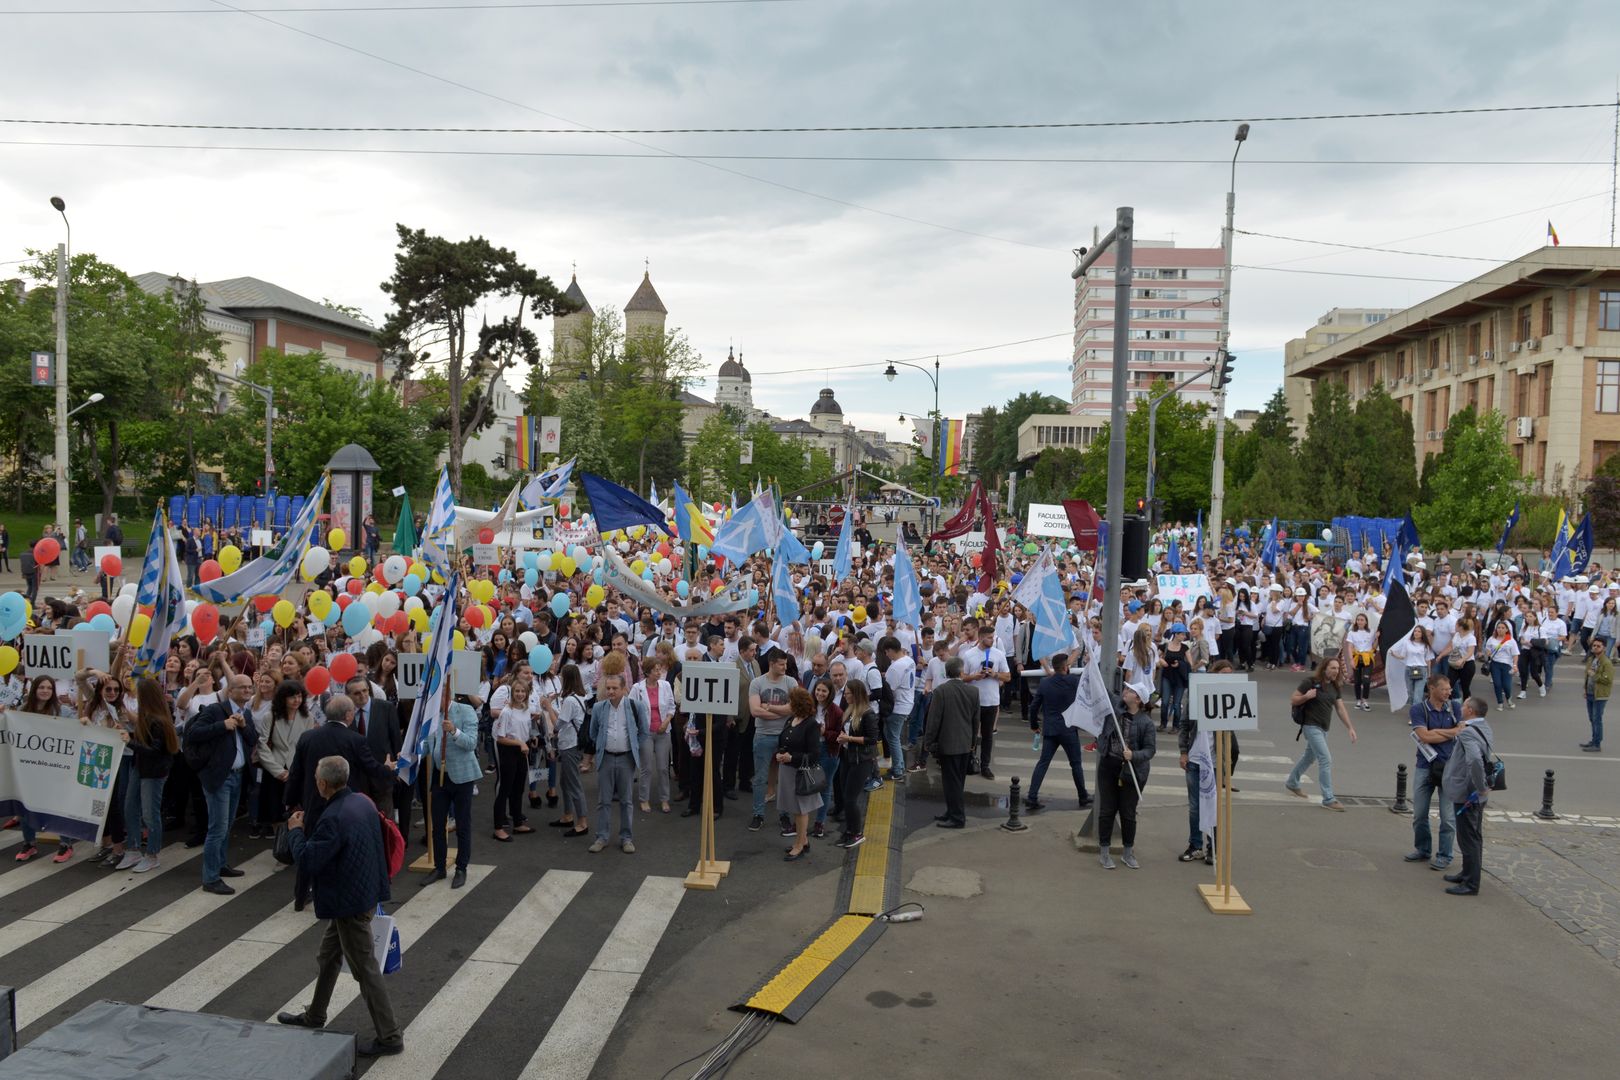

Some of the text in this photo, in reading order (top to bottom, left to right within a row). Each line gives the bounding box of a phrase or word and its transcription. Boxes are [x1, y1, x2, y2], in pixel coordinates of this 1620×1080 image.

[1037, 512, 1068, 520] FACULTAT
[403, 663, 424, 687] U.
[685, 677, 733, 704] U.T.I.
[1203, 693, 1256, 719] U.P.A.
